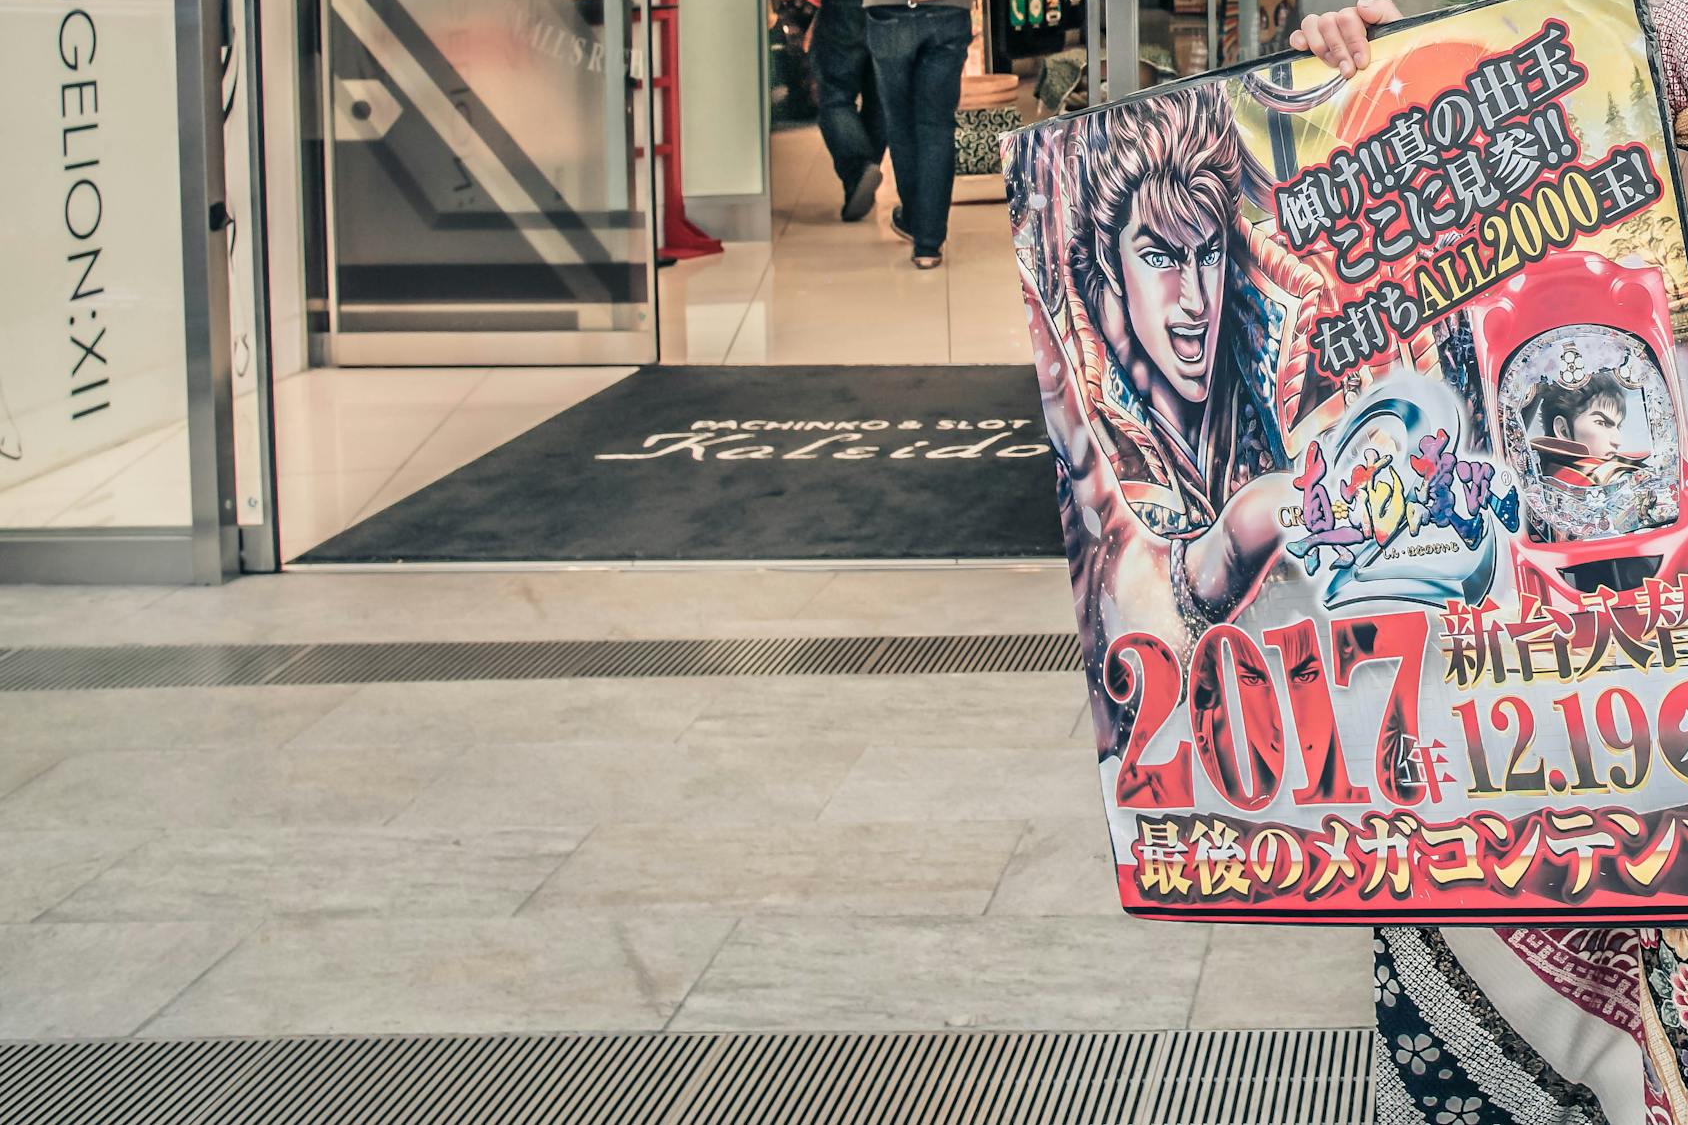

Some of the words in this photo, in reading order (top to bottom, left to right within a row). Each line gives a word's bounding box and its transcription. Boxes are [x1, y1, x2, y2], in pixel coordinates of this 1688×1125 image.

[690, 419, 889, 431] PACHINKO
[936, 419, 1033, 431] SLOT
[594, 431, 1052, 462] Kaleido
